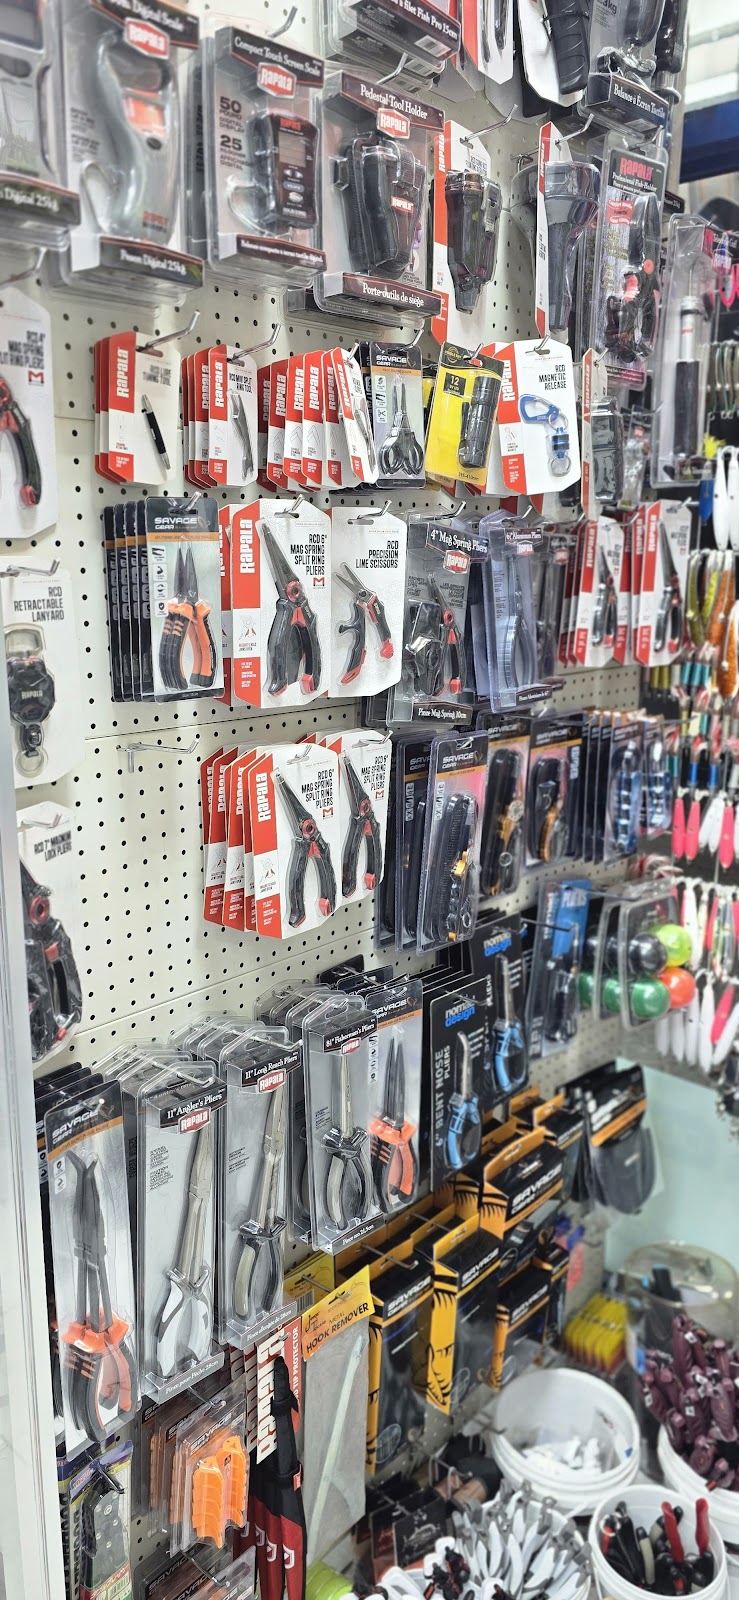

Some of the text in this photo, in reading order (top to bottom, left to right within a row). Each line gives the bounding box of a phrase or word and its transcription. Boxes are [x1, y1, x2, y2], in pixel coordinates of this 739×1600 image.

[417, 7, 431, 25] Fish
[431, 16, 442, 32] Pro
[234, 36, 321, 77] Compact Touch Screen Scale
[613, 83, 633, 103] Balance
[220, 96, 242, 113] 50
[360, 84, 428, 120] Pedestal Tool Holder
[220, 134, 242, 151] 25
[400, 291, 409, 303] de
[408, 291, 425, 308] siège
[375, 354, 407, 364] SAVAGE
[555, 364, 566, 372] RCD
[450, 375, 460, 386] 12
[538, 373, 567, 383] MAGNETIC
[544, 381, 567, 391] RELEASE
[154, 517, 198, 525] SAVAGE
[309, 533, 320, 544] RCD
[386, 540, 399, 550] RCD
[430, 530, 488, 554] 4" Mag Spring Pliers
[290, 544, 325, 555] MAG SPRING
[368, 549, 399, 559] PRECISION
[294, 554, 325, 565] SPLIT RING
[369, 559, 399, 569] SCISSORS
[305, 565, 325, 576] PLIERS
[48, 586, 63, 597] RCD
[14, 598, 64, 612] RETRACTABLE
[31, 610, 65, 622] LANYARD
[374, 755, 384, 766] RCD
[442, 752, 474, 764] SAVAGE
[317, 770, 328, 781] RCD
[361, 764, 386, 777] MAG SPRING
[363, 772, 386, 785] SPLIT RING
[301, 779, 333, 795] MAG SPRING
[370, 780, 386, 792] PLIERS
[305, 788, 333, 802] SPLIT RING
[315, 798, 334, 809] PLIERS
[445, 1006, 475, 1027] design
[362, 1022, 375, 1034] Pliers
[253, 1064, 267, 1077] Long
[267, 1059, 284, 1071] Reach
[283, 1055, 298, 1066] Pliers
[435, 1050, 444, 1089] NOSE
[167, 1092, 223, 1119] 11" Angler's Pliers
[435, 1090, 444, 1127] BENT
[52, 1110, 99, 1139] SAVAGE
[52, 1128, 73, 1145] GEAR
[511, 1163, 562, 1206] SAVAGE
[461, 1248, 499, 1282] SAVAGE
[387, 1275, 432, 1311] SAVAGE
[511, 1285, 549, 1318] SAVAGE
[387, 1303, 408, 1317] GEAR
[306, 1328, 330, 1353] HOOK
[331, 1302, 369, 1333] REMOVER
[190, 1412, 232, 1450] SAVAGE
